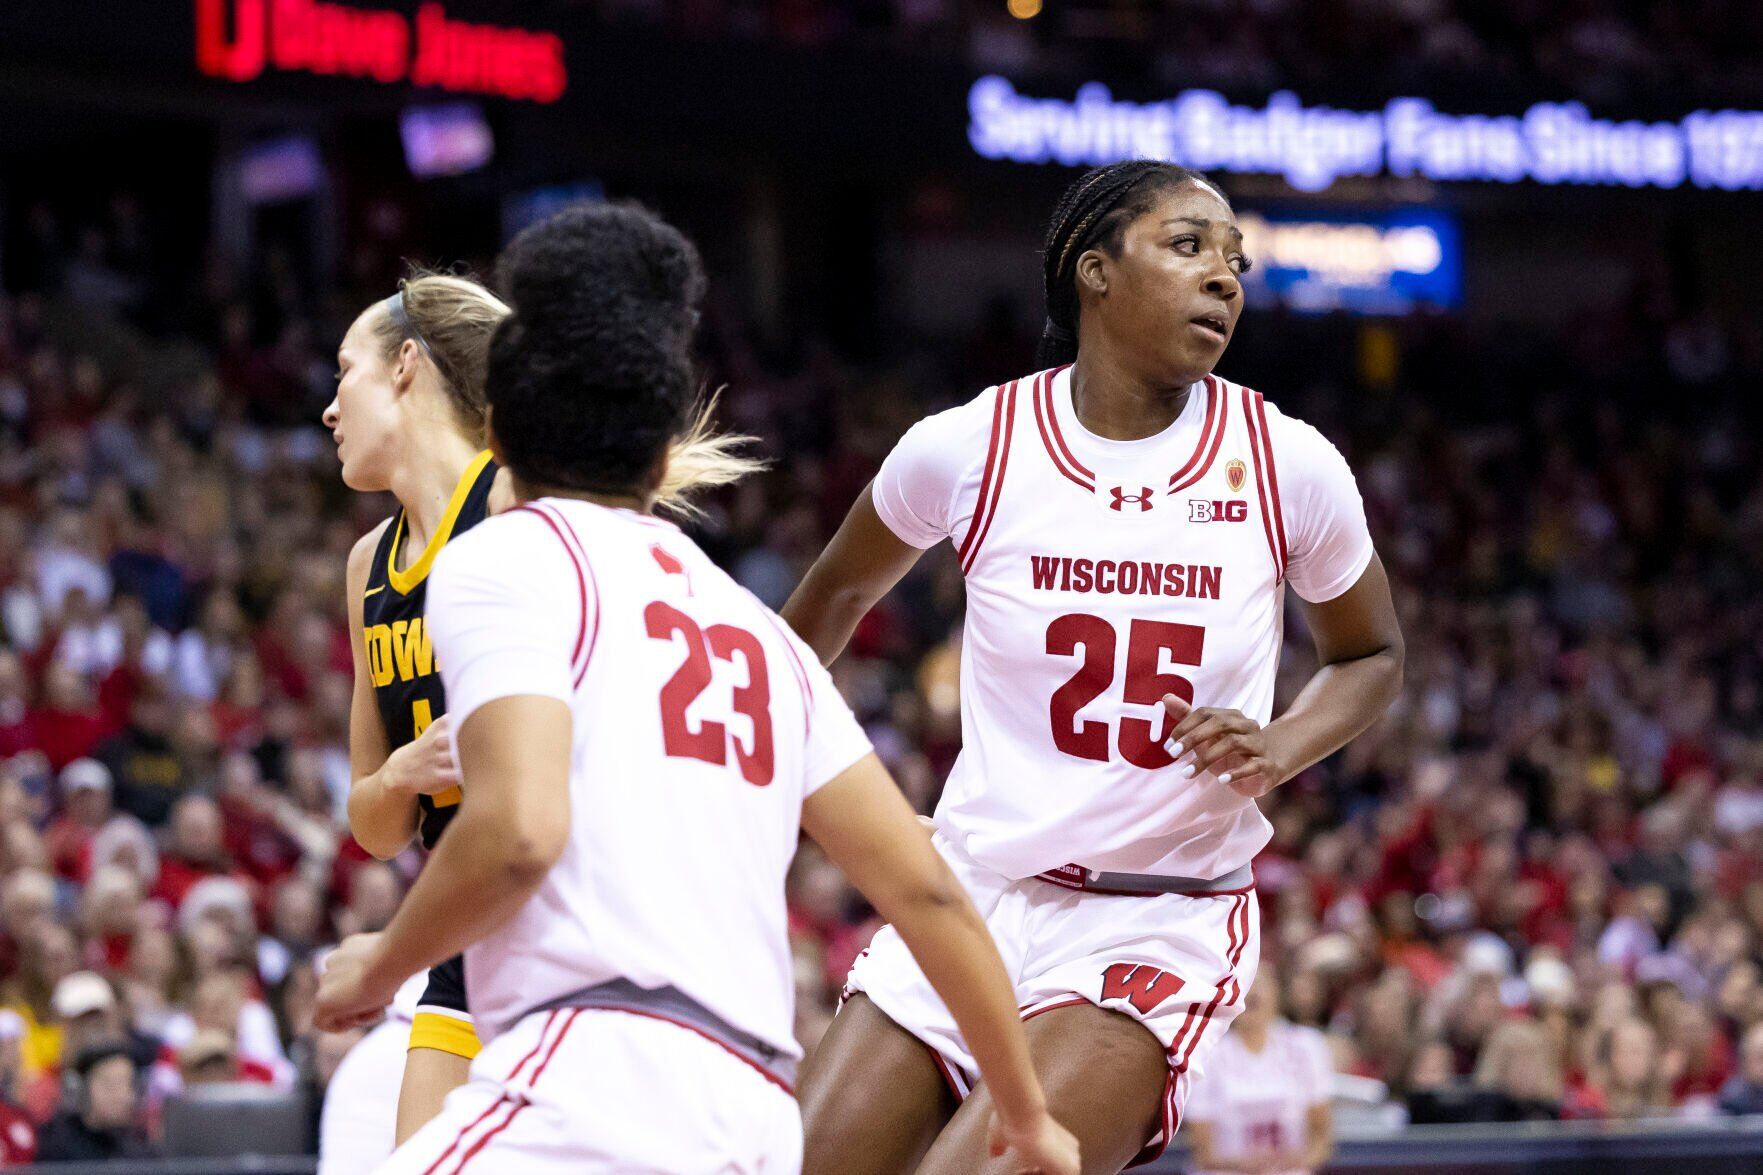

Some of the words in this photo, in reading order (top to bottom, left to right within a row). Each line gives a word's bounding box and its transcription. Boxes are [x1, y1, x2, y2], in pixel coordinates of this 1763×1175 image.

[968, 76, 1173, 166] Serving
[1177, 89, 1382, 191] Badger
[1385, 98, 1524, 183] Fans
[1524, 101, 1683, 188] Since
[1031, 555, 1222, 600] WISCONSIN
[643, 600, 775, 787] 23
[1045, 613, 1206, 770] 25
[1100, 961, 1186, 1015] W
